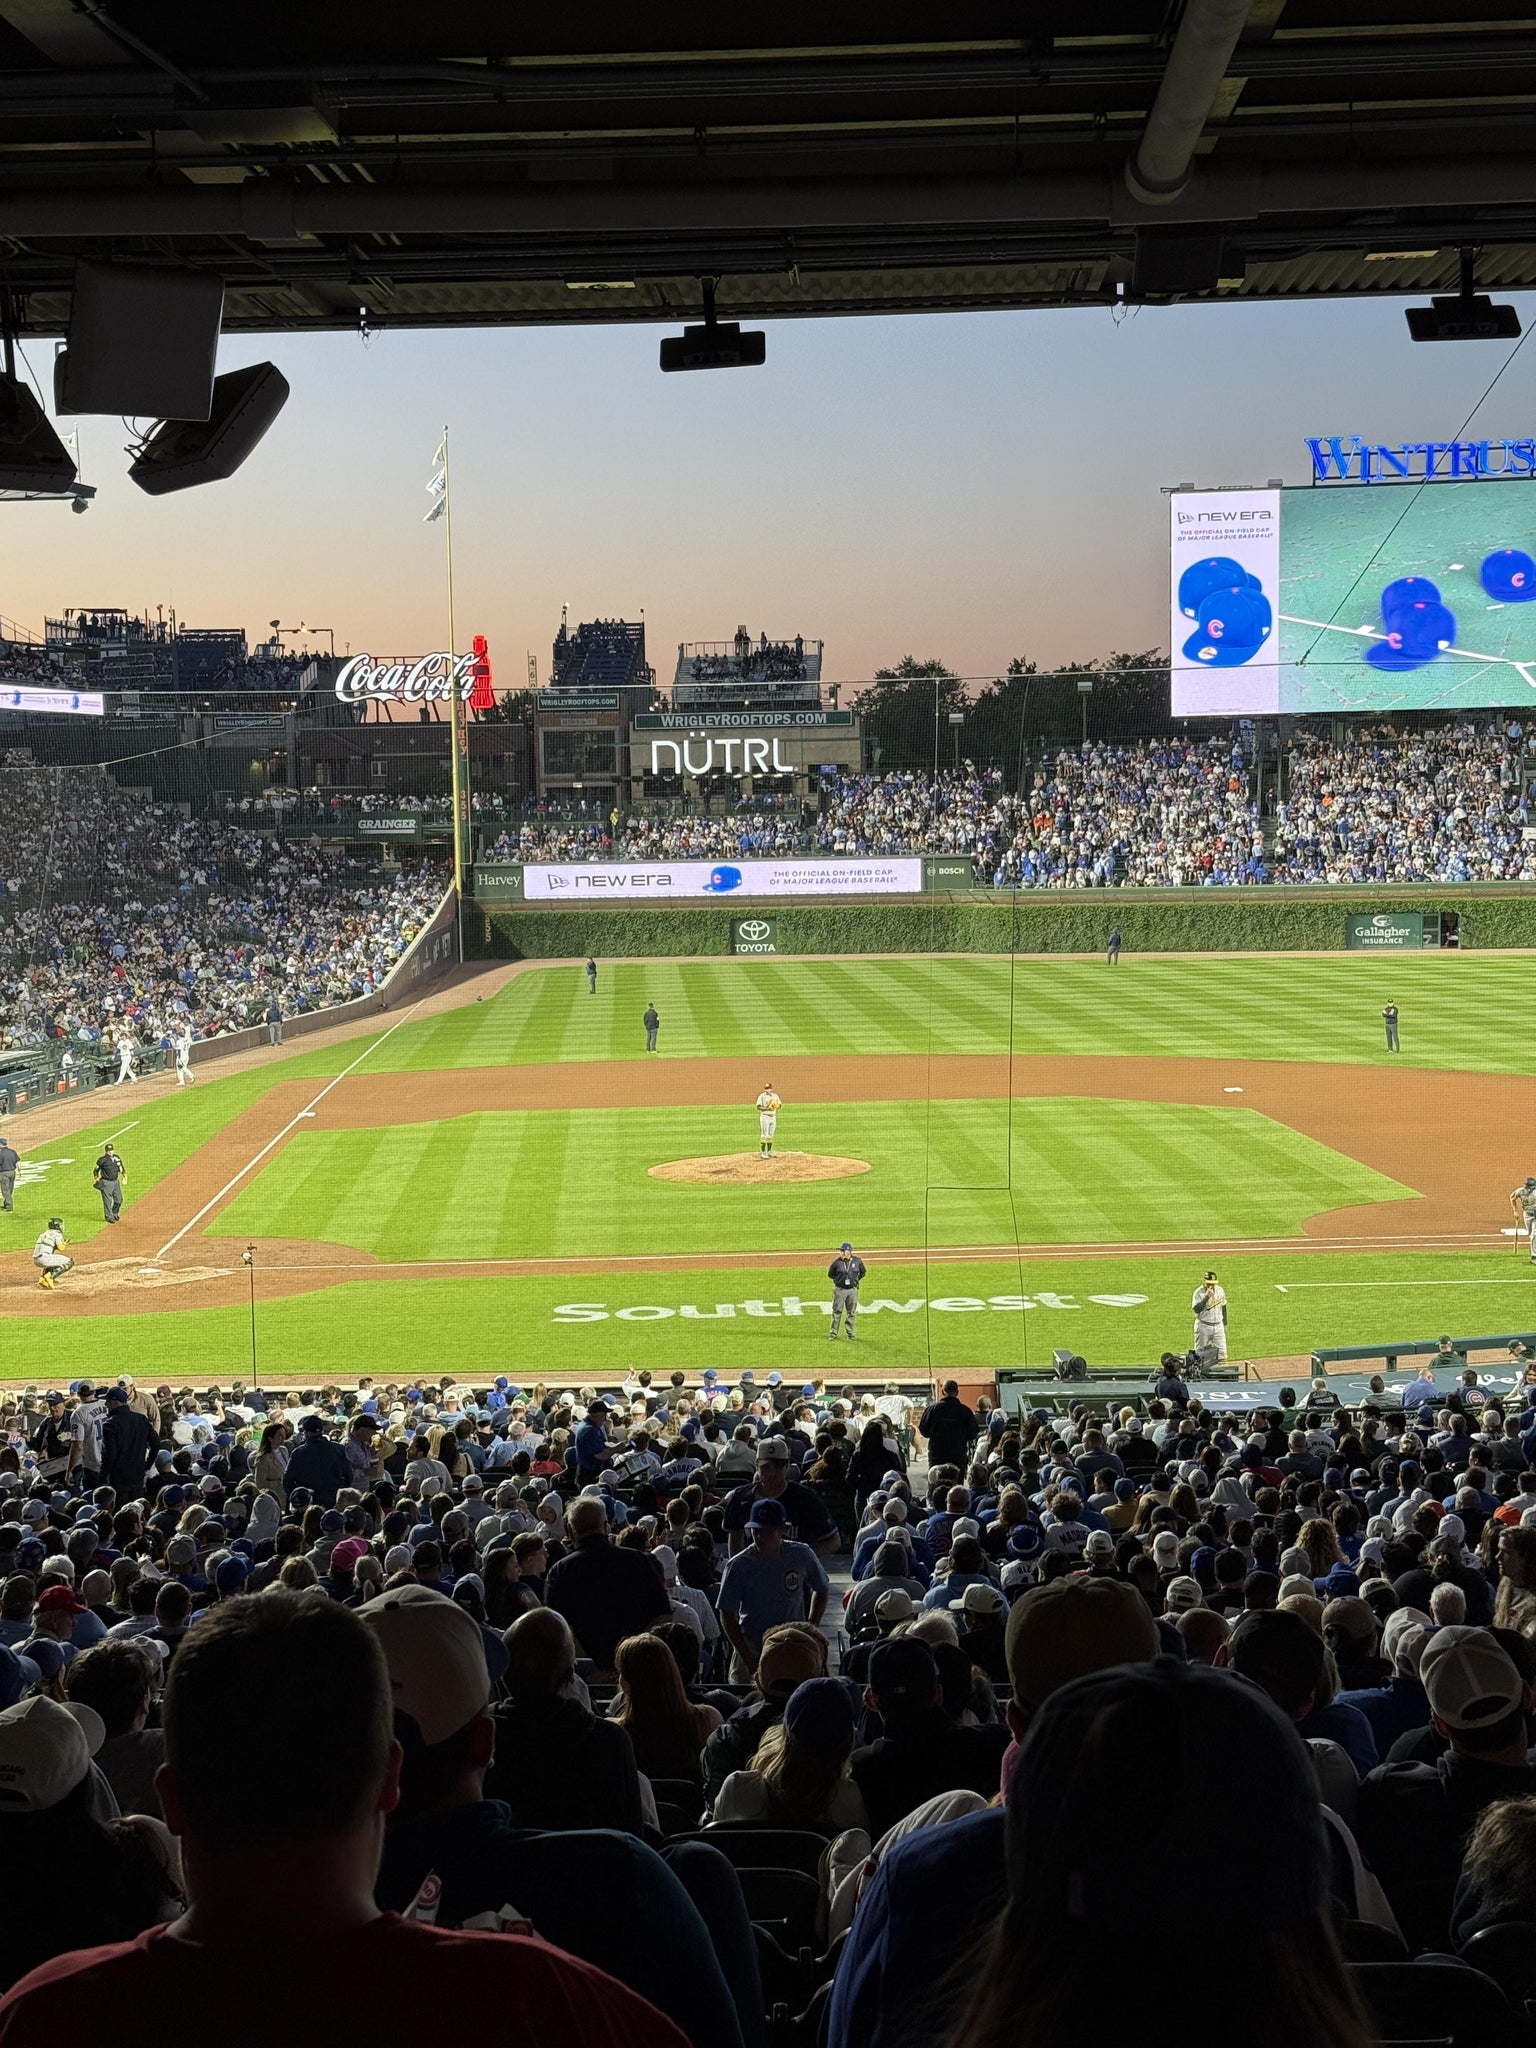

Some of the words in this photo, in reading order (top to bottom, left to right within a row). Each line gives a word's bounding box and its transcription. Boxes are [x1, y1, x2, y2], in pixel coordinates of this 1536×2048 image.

[1304, 435, 1536, 481] WINTRUS
[335, 652, 484, 704] Coca-Cola
[661, 712, 827, 727] WRIGLEYROOFTOPS.COM
[357, 819, 417, 829] GRAINGER
[832, 869, 872, 877] ON-FIELD
[938, 867, 965, 875] BOSCH
[477, 873, 520, 888] Harvey
[1354, 926, 1411, 938] Gallagher
[1362, 937, 1404, 945] INSURANCE
[734, 943, 776, 953] TOYOTA
[553, 1291, 1081, 1323] Southwest
